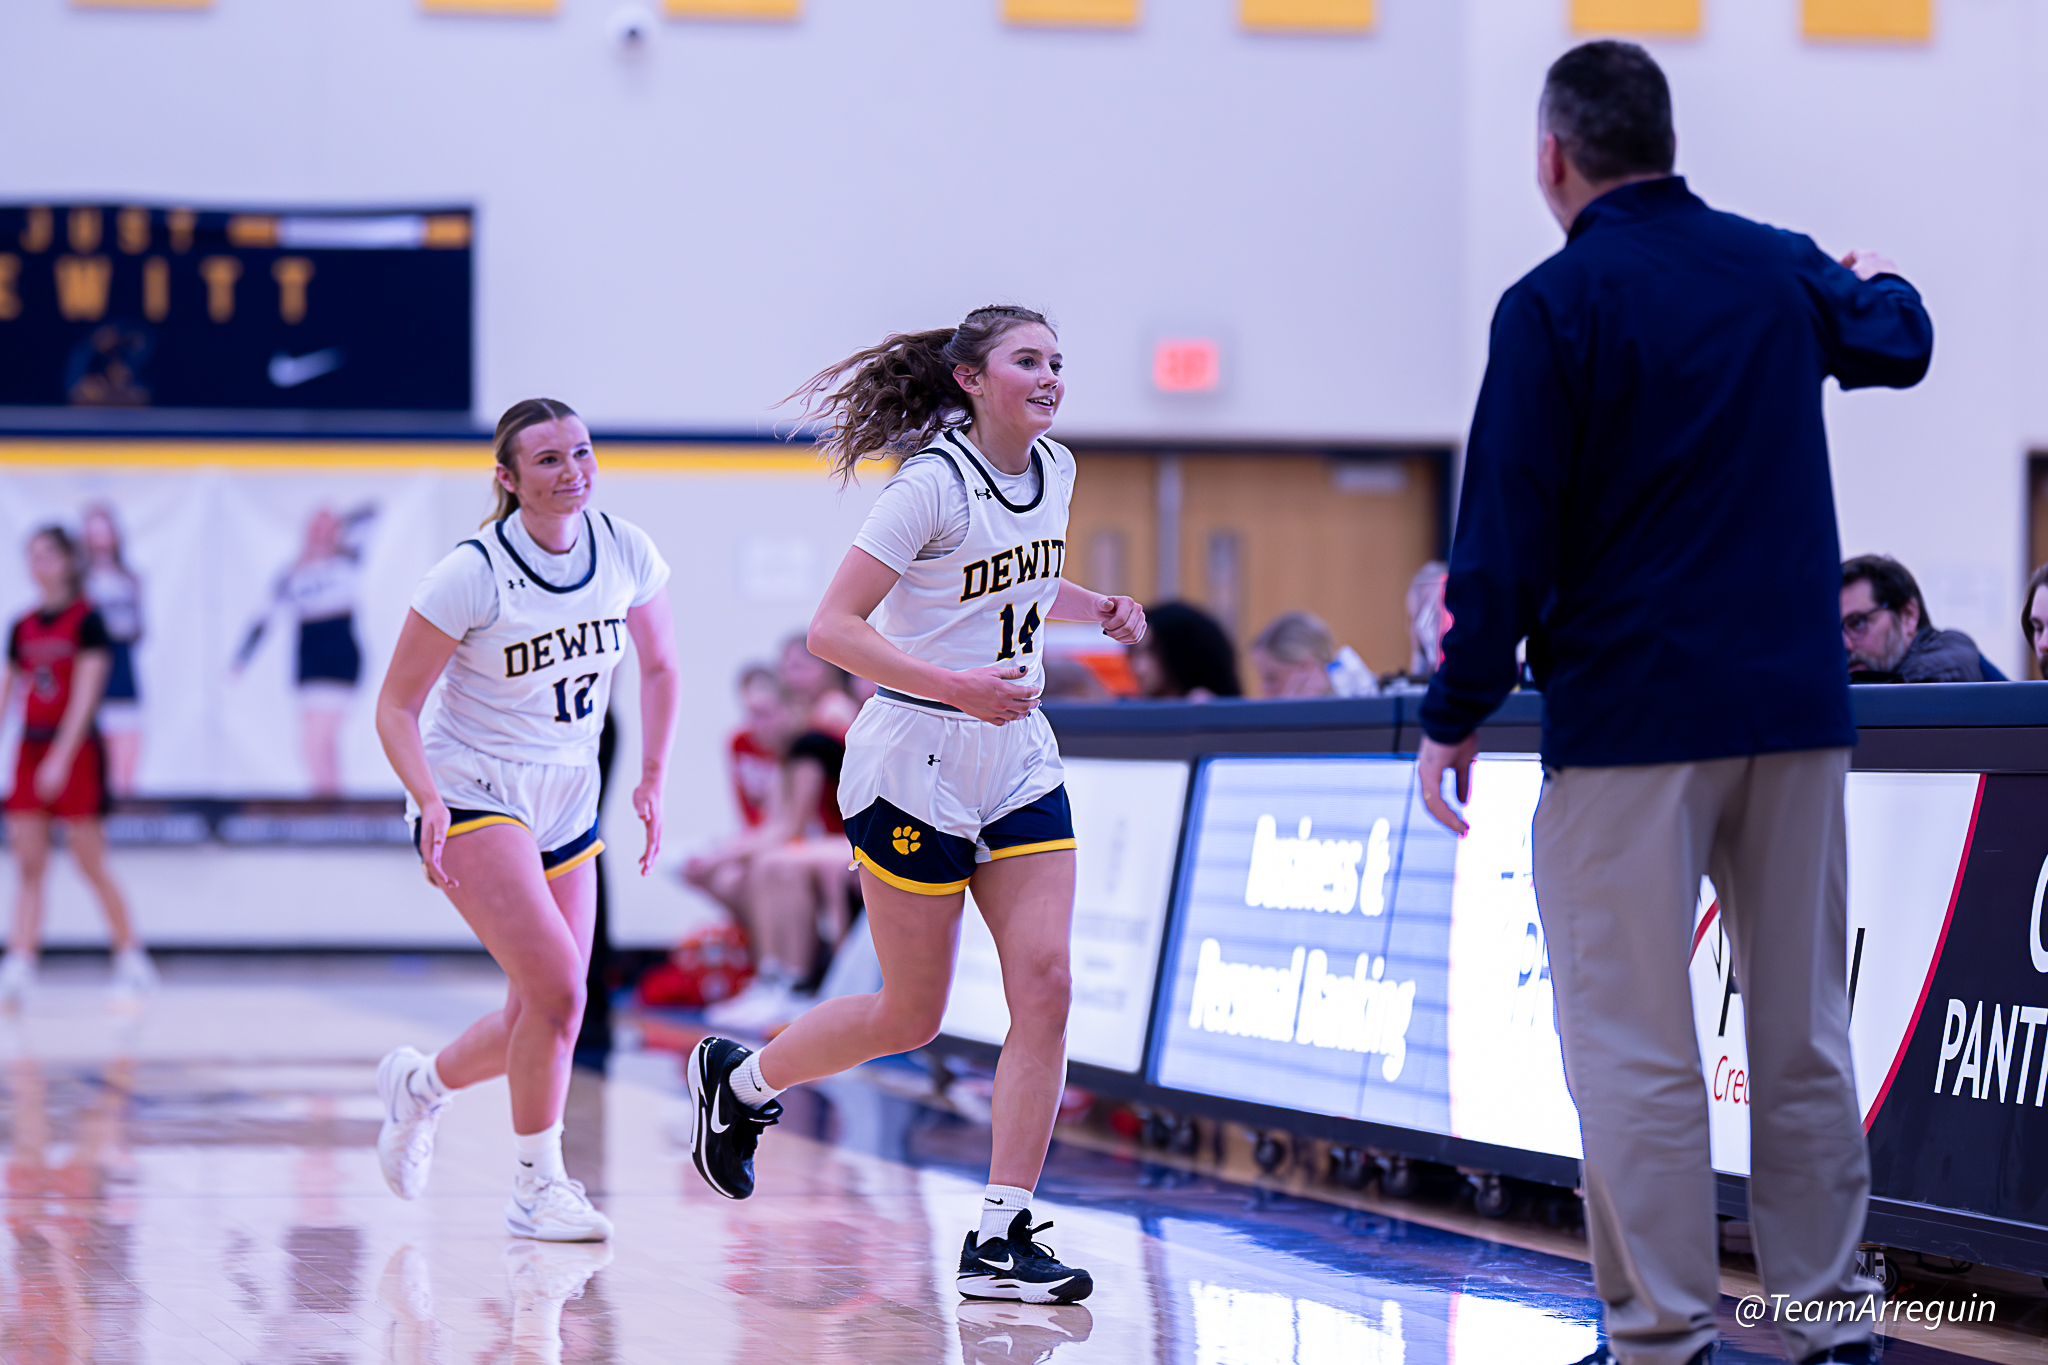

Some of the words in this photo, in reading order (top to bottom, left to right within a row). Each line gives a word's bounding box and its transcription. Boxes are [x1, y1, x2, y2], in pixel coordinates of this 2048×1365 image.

[503, 618, 626, 678] DEWIT
[996, 602, 1041, 662] 14
[552, 672, 599, 723] 12
[1934, 998, 2048, 1107] PANT
